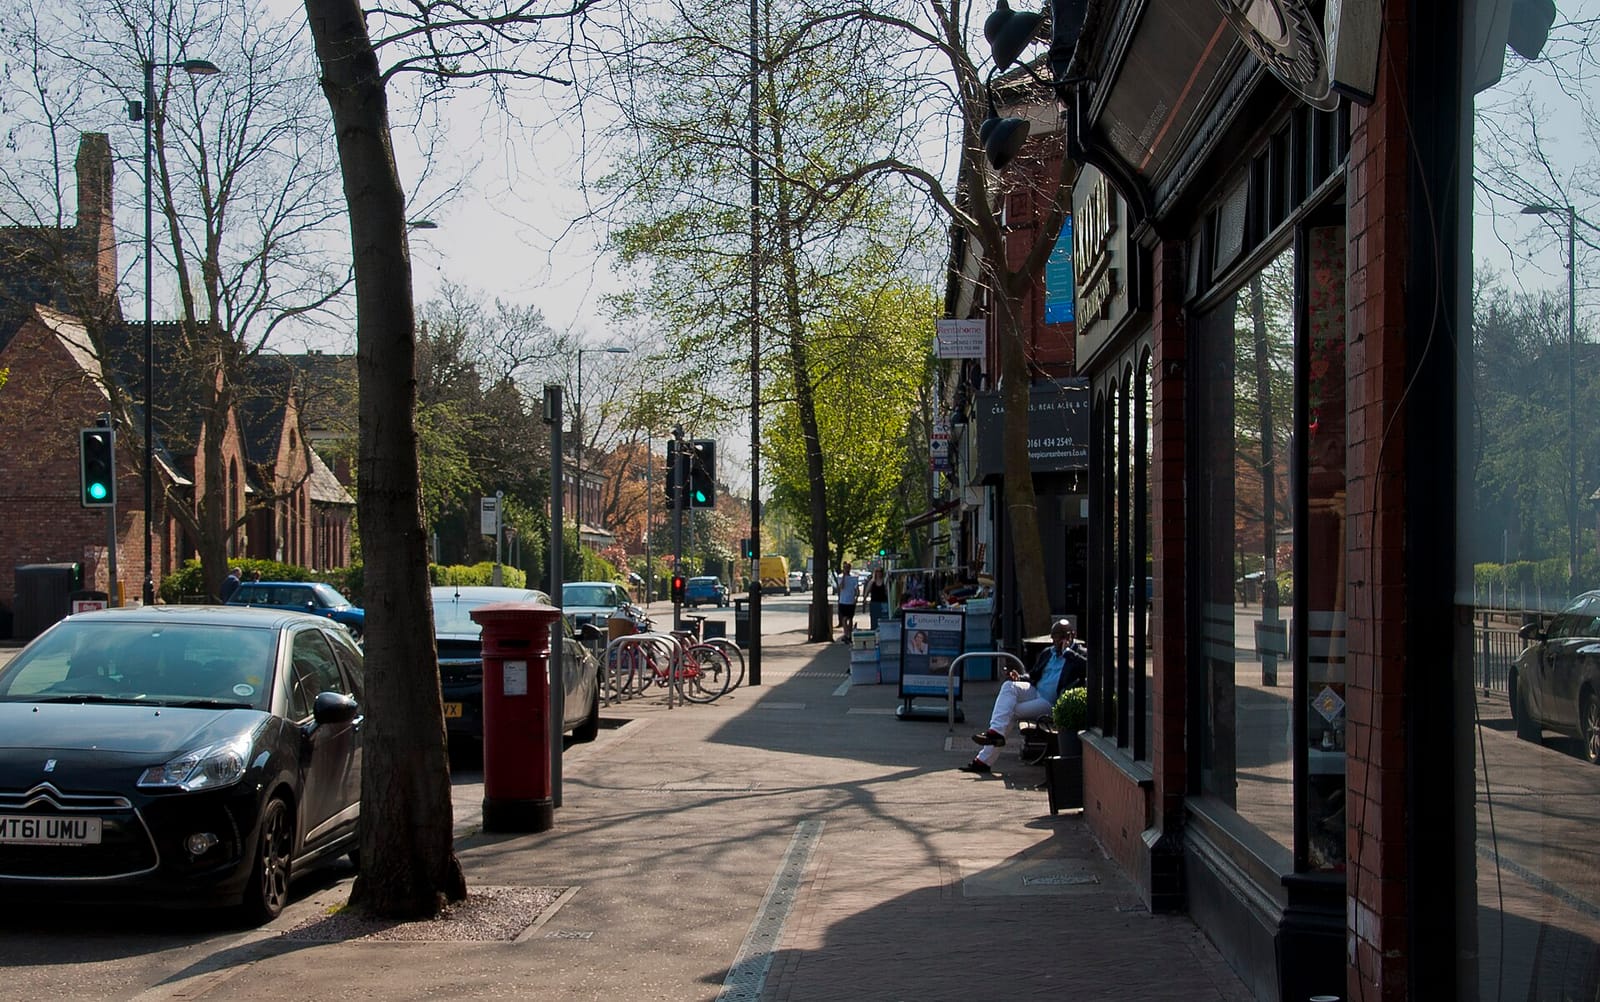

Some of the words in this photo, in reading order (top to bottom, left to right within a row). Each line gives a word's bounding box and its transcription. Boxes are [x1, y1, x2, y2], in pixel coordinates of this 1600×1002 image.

[1038, 403, 1055, 411] REAL
[1043, 438, 1055, 447] 434
[46, 820, 87, 839] UMU
